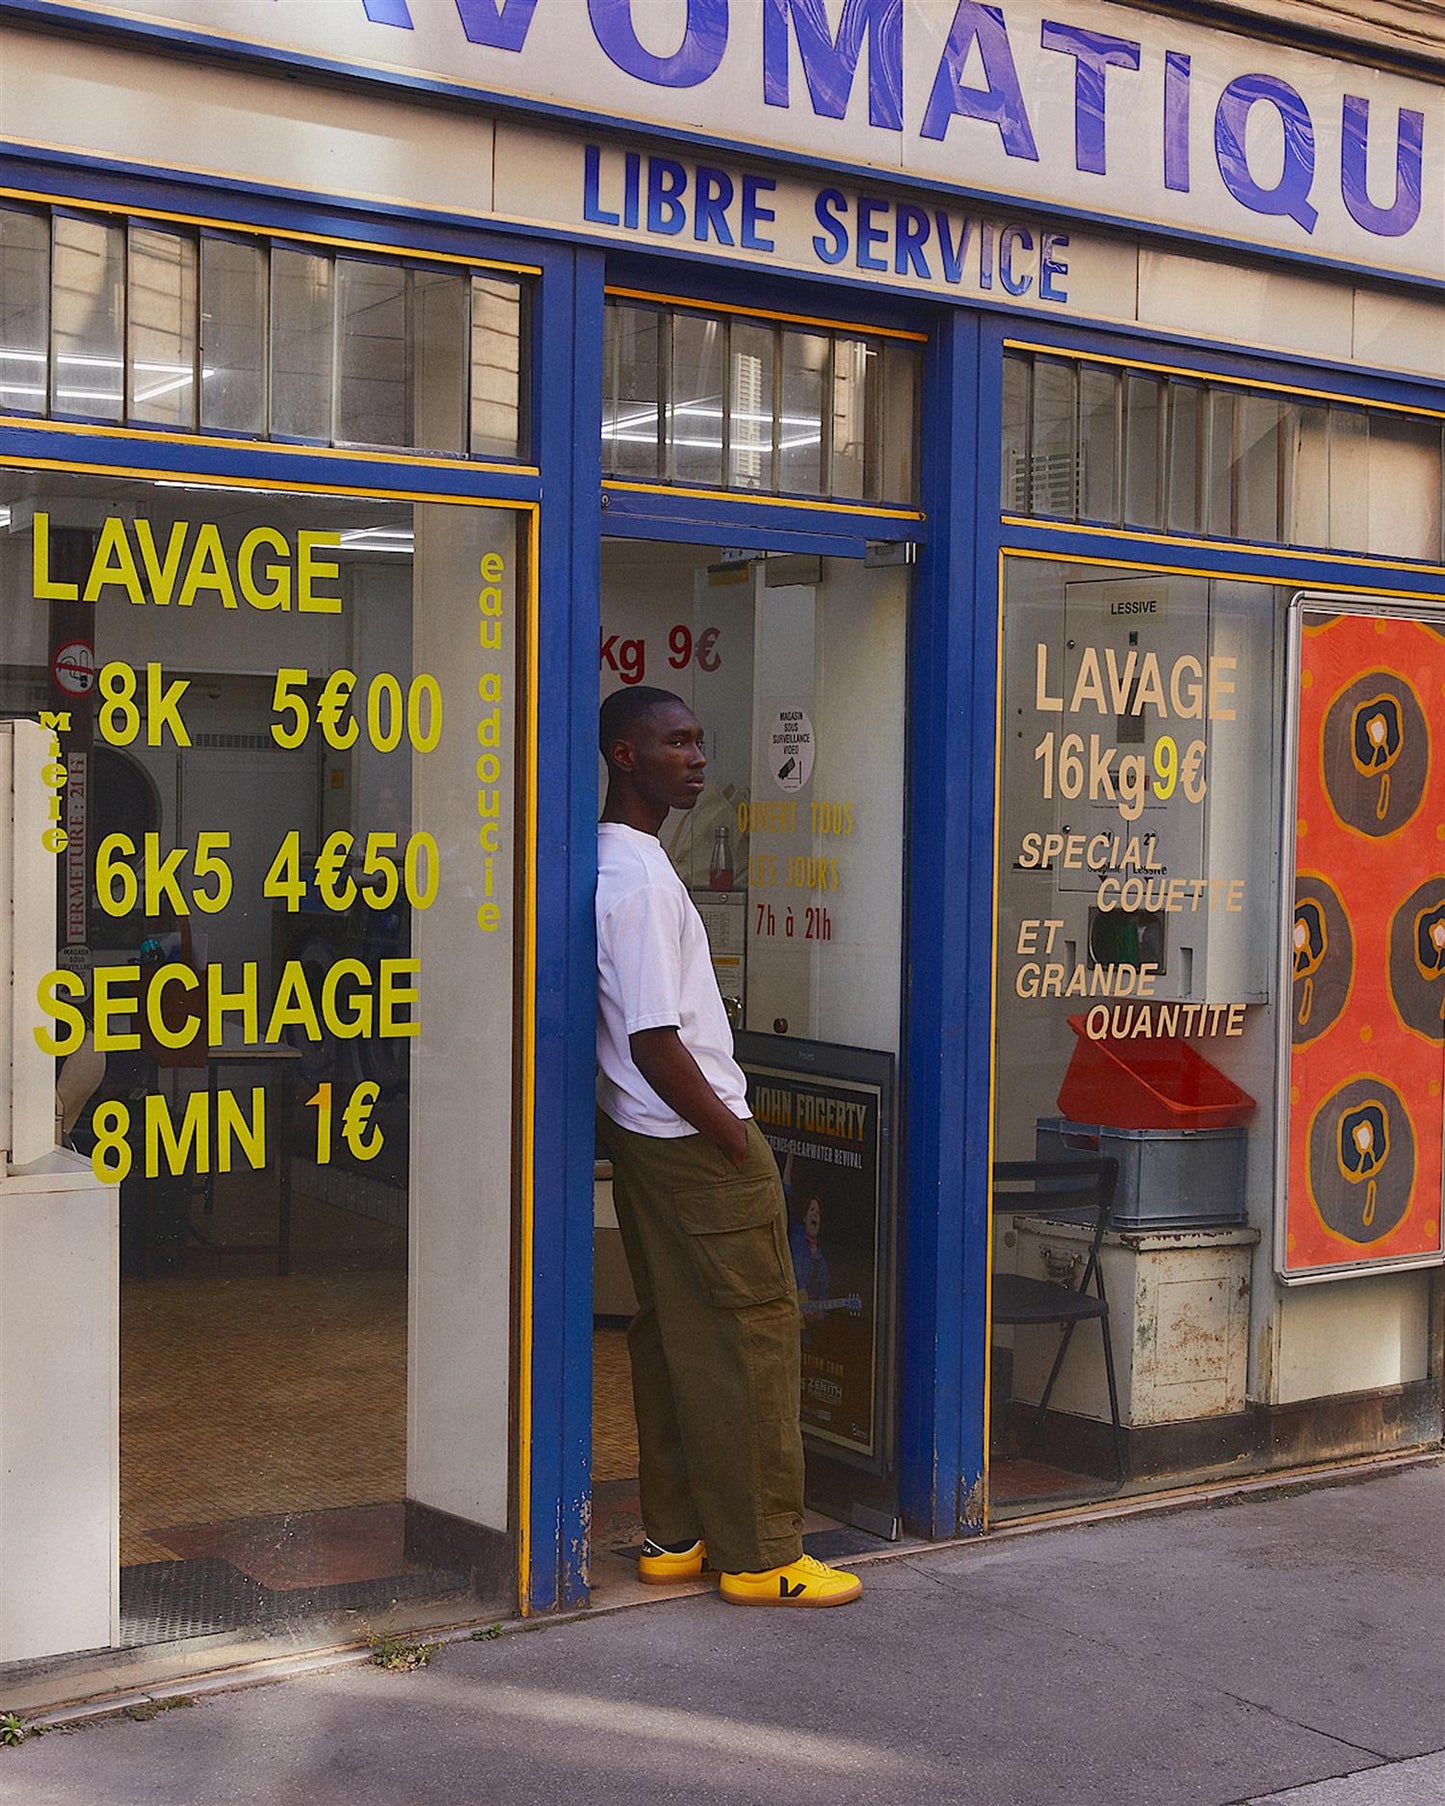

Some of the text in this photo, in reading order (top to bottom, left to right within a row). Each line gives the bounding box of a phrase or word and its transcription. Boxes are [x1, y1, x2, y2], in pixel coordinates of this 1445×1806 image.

[583, 145, 1069, 303] LIBRE SERVICE
[33, 511, 342, 614] LAVAGE
[1110, 600, 1157, 615] LESSIVE
[667, 624, 722, 673] 9€
[1035, 643, 1238, 721] LAVAGE
[98, 661, 444, 754] 8k 5€00
[780, 711, 803, 721] MAGASIN
[475, 551, 504, 932] eau adoucie
[772, 733, 811, 744] SURVEILLANCE
[784, 722, 799, 732] SOUS
[39, 710, 72, 853] Miele
[736, 800, 854, 836] OUVERT TOUS
[1018, 832, 1163, 870] SPECIAL
[68, 816, 85, 936] FERMETURE
[95, 830, 440, 918] 6k5 4€50
[748, 853, 840, 891] LES JOURS
[1096, 877, 1246, 913] COUETTE
[756, 903, 776, 937] 7h
[785, 905, 794, 938] à
[804, 906, 832, 941] 21h
[1016, 920, 1064, 955] ET
[1015, 962, 1159, 998] GRANDE
[33, 957, 422, 1058] SECHAGE
[1086, 1003, 1247, 1040] QUANTITE
[304, 1080, 386, 1165] 1€
[752, 1086, 868, 1142] JOHN FOGERTY
[834, 1148, 863, 1170] REVIVAL
